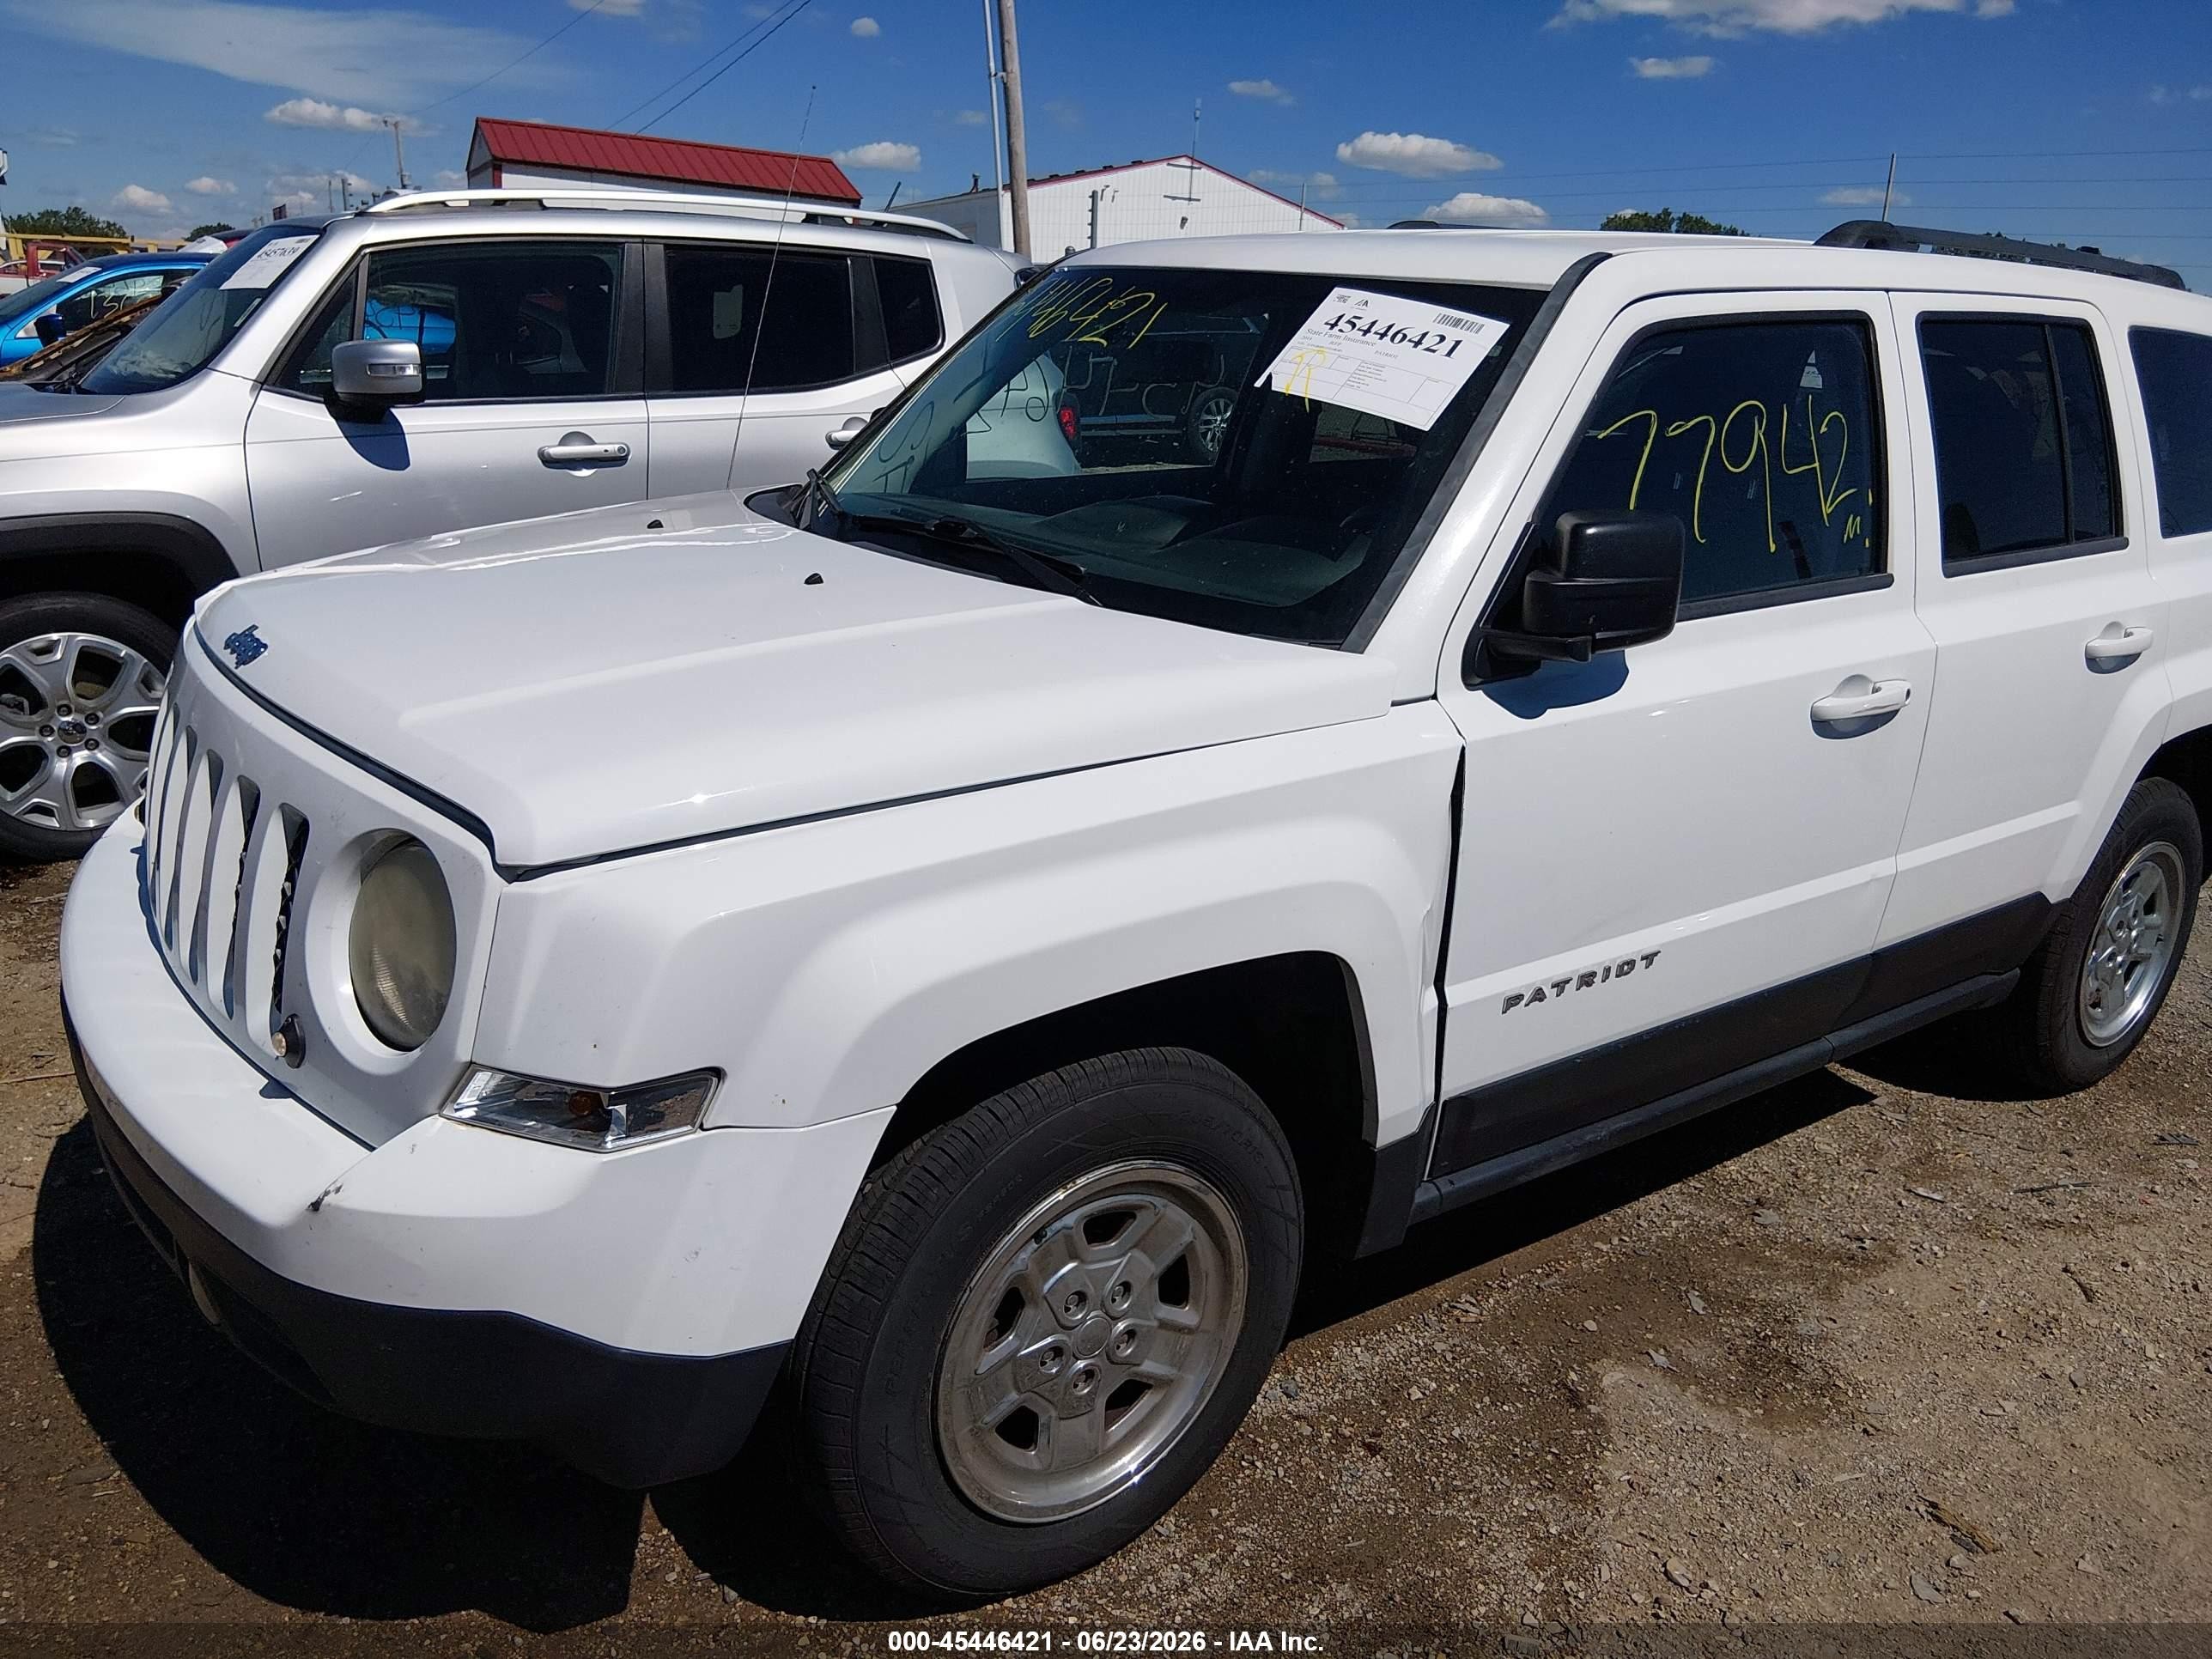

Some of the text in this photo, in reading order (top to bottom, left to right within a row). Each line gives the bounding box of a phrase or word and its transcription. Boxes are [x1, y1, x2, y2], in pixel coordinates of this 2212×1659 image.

[1307, 328, 1323, 337] State
[1323, 331, 1342, 340] Farm
[1343, 335, 1376, 347] Insurance
[1323, 313, 1463, 359] 45446421
[1596, 394, 1857, 553] 77942
[1501, 950, 1662, 1015] PATRIOT
